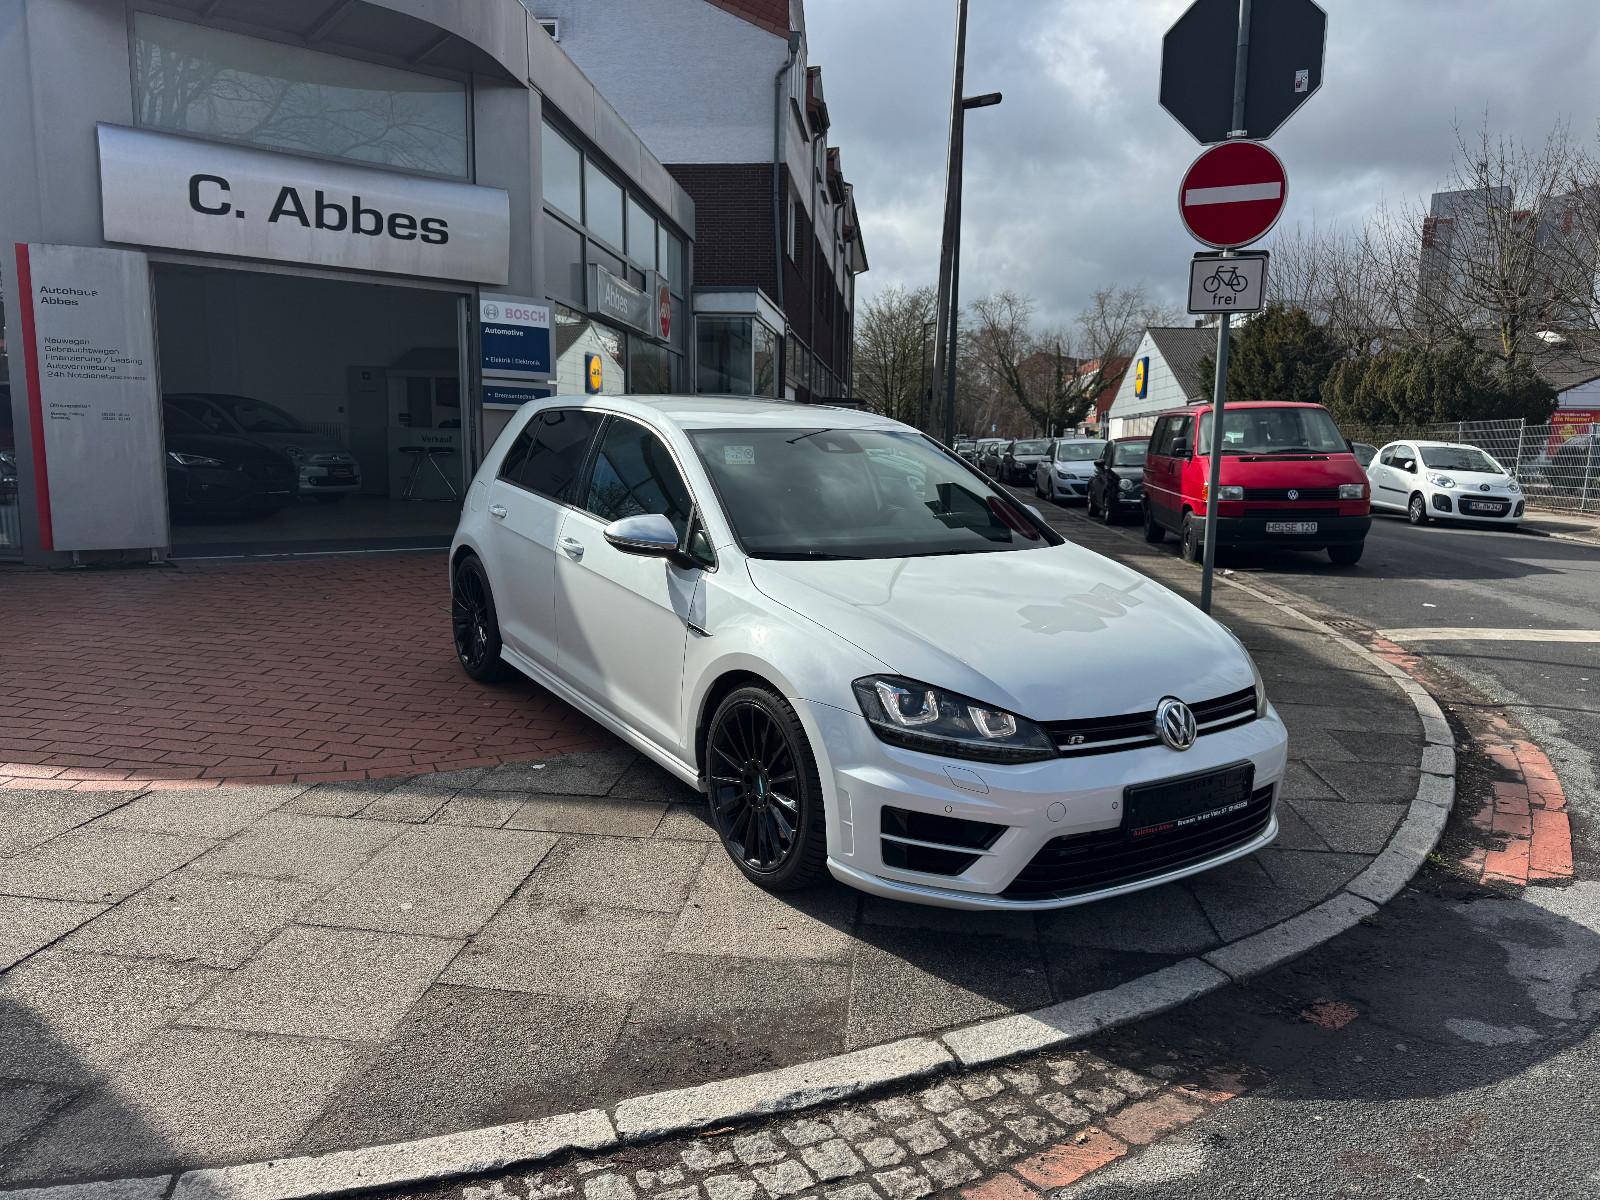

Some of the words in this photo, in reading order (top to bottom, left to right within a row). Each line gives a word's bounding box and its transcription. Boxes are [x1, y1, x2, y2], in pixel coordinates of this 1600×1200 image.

[189, 173, 245, 219] C.
[268, 186, 449, 245] Abbes
[41, 297, 79, 306] Abbes
[605, 283, 628, 313] Abbes
[1212, 293, 1237, 306] frei
[505, 308, 546, 322] BOSCH
[485, 326, 524, 337] Automotive
[44, 336, 90, 346] Neuwagen
[44, 345, 120, 355] Gebrauchtwagen
[45, 354, 102, 364] Finanzierung
[110, 357, 143, 366] Leasing
[490, 356, 511, 364] Elektrik
[515, 357, 541, 366] Elektronik
[46, 362, 116, 372] Autovermietung
[47, 370, 65, 378] 24h
